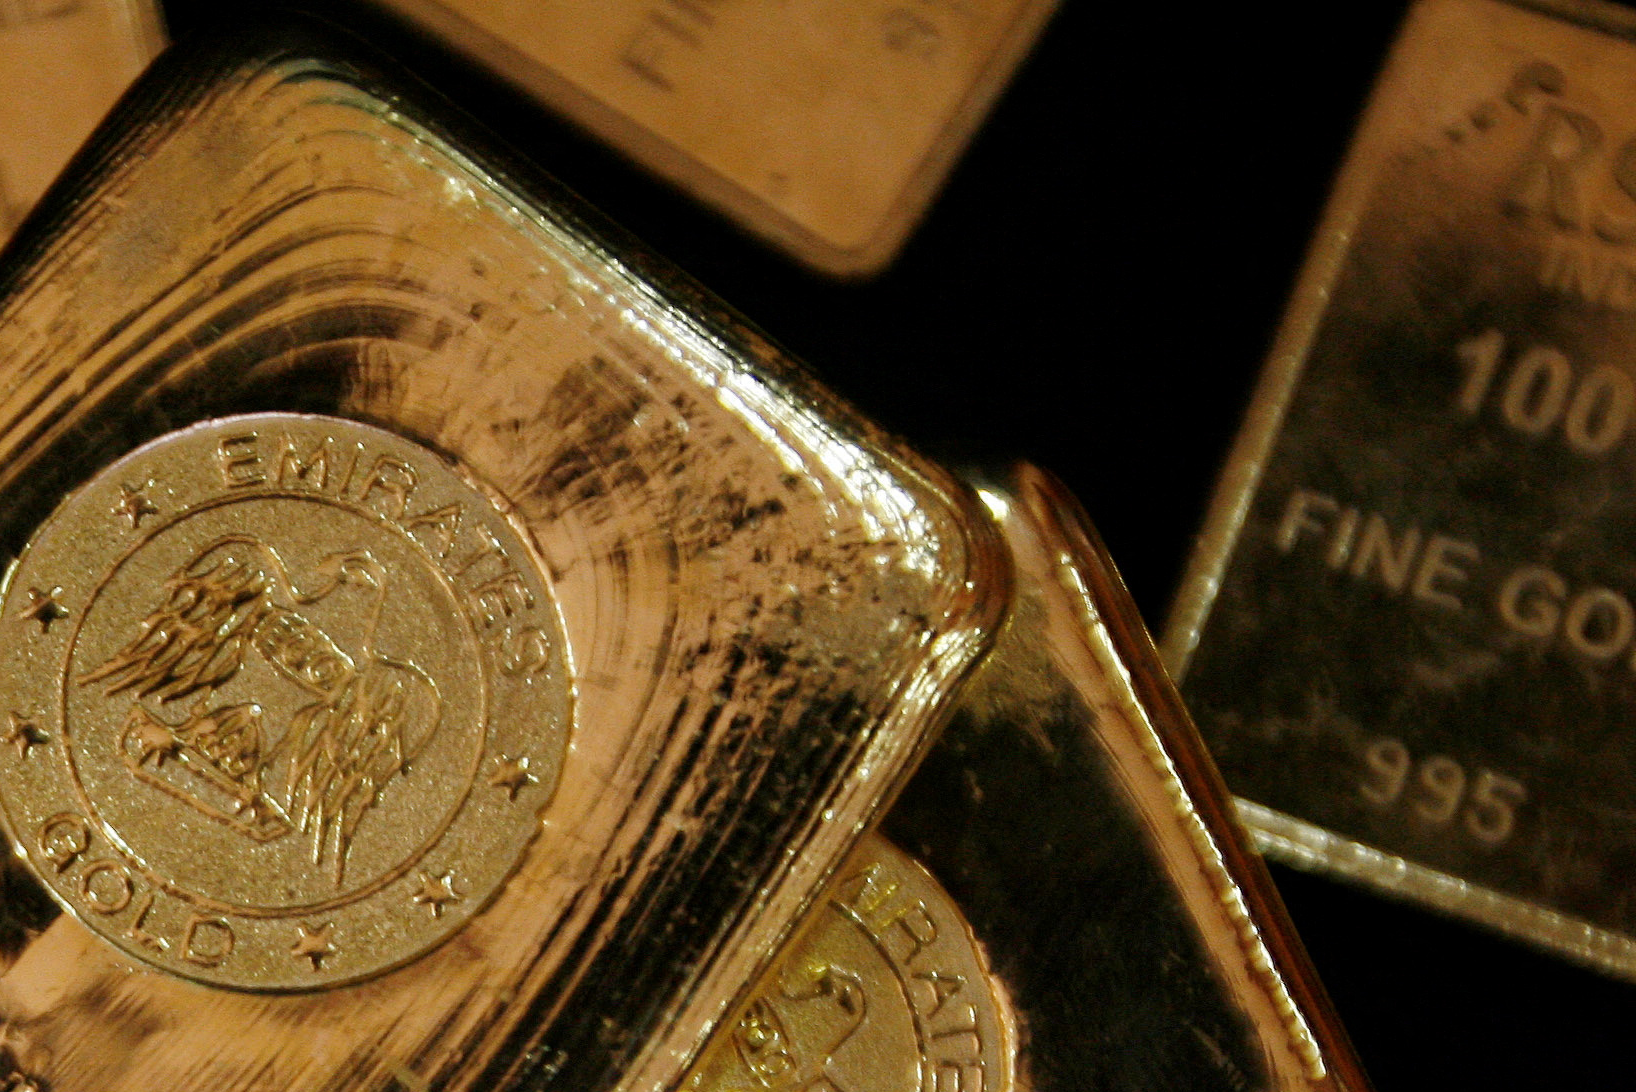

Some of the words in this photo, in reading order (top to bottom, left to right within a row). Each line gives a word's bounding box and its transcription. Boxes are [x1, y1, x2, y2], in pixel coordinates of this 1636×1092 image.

[1454, 326, 1636, 455] 100
[215, 430, 551, 684] EMIRATES
[1272, 488, 1482, 612] FINE
[1497, 565, 1636, 674] GO
[1361, 737, 1525, 846] 995
[38, 810, 236, 969] GOLD
